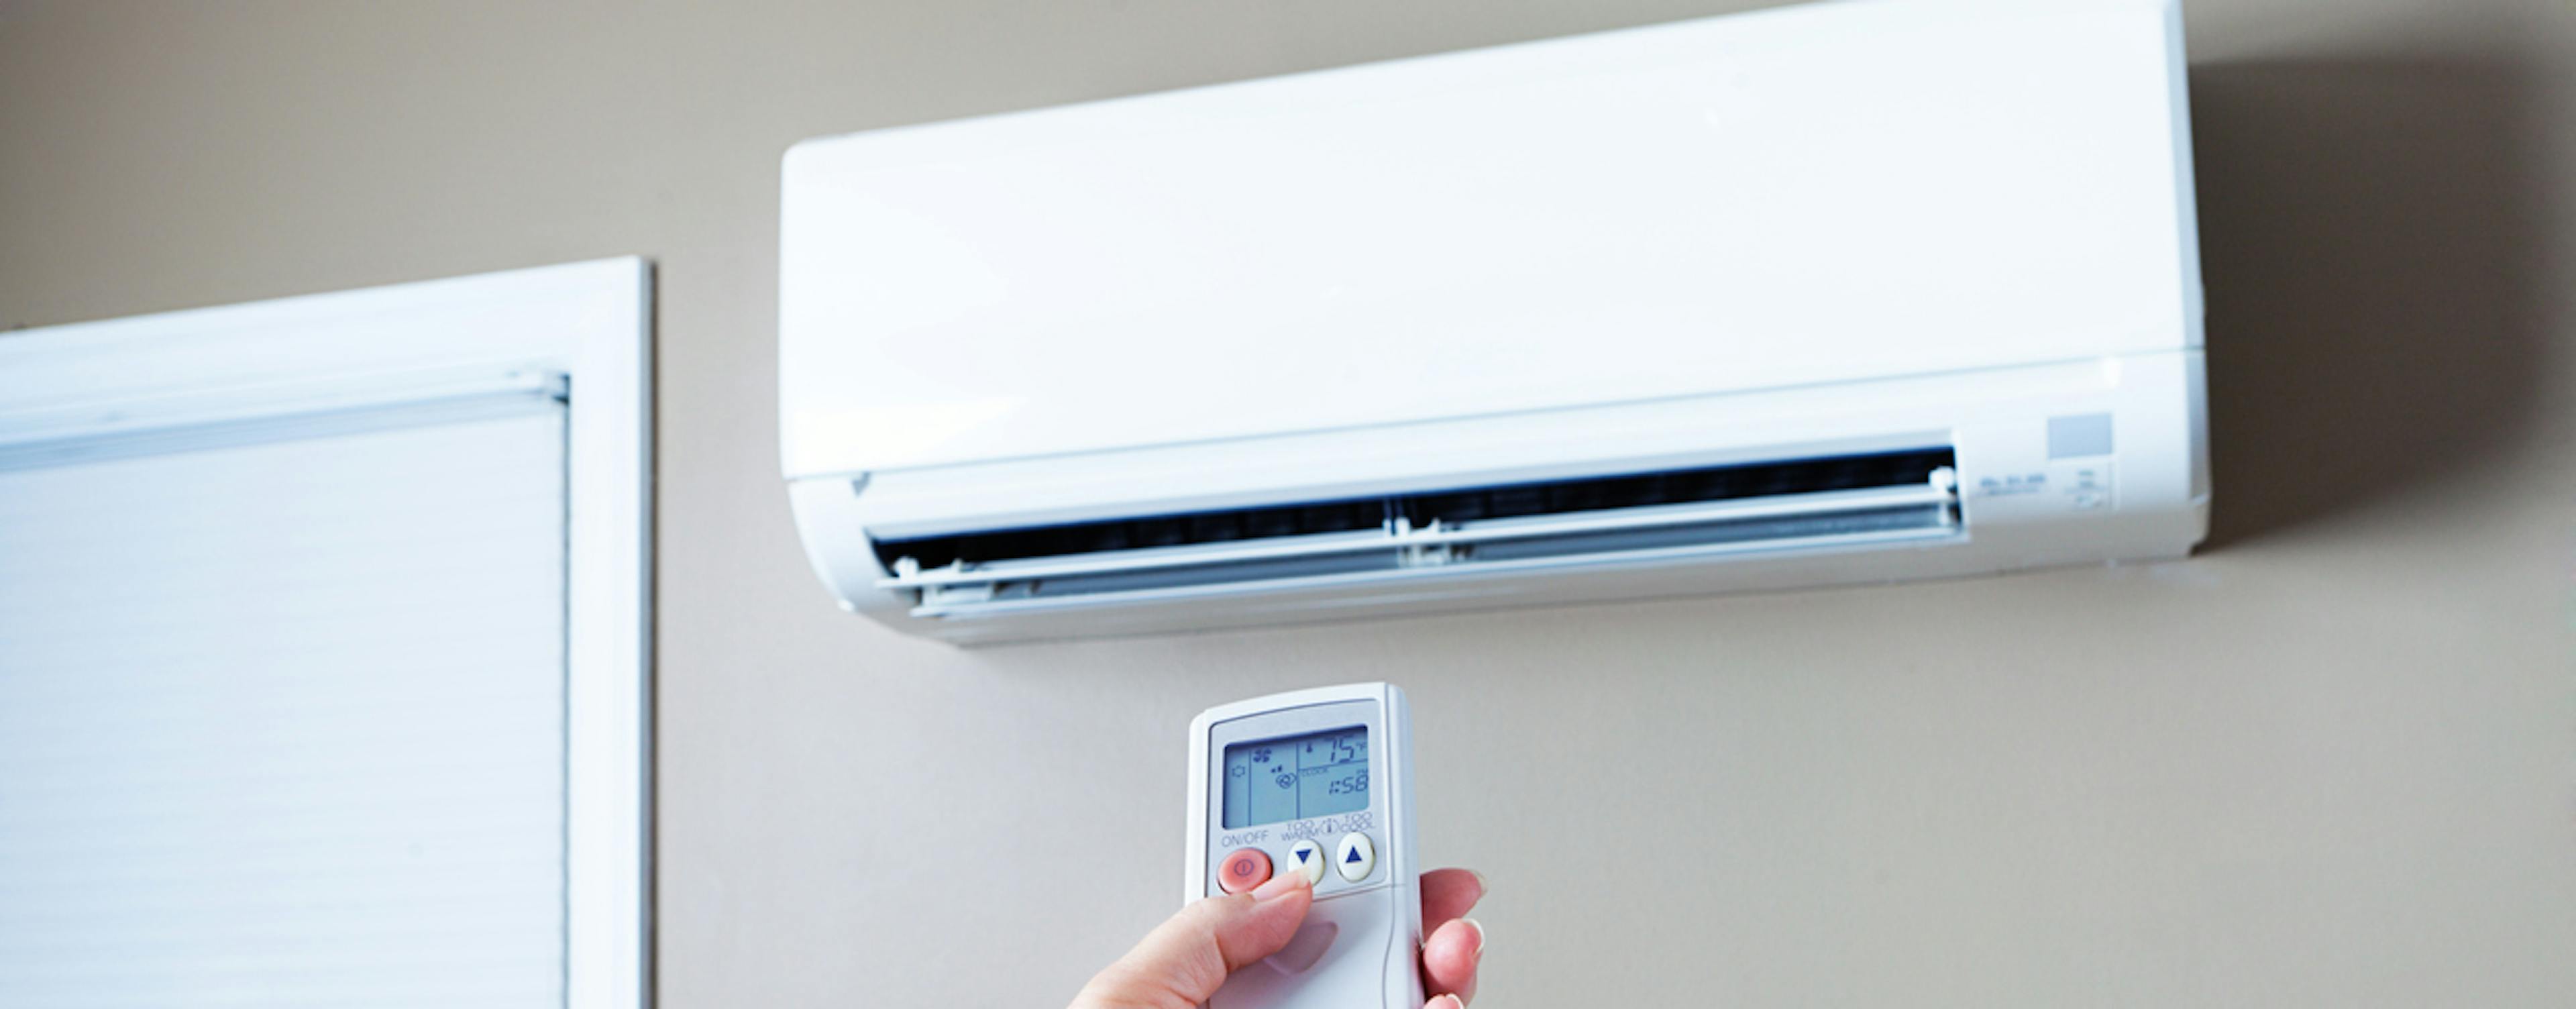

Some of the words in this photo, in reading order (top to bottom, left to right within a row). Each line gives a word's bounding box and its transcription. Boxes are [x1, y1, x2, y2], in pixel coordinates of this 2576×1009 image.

[1329, 775, 1368, 794] 1:58
[1345, 811, 1373, 822] TOO
[1287, 819, 1314, 831] TOO
[1341, 820, 1375, 832] COOL
[1221, 830, 1269, 847] ON/OFF
[1281, 827, 1319, 841] WARM
